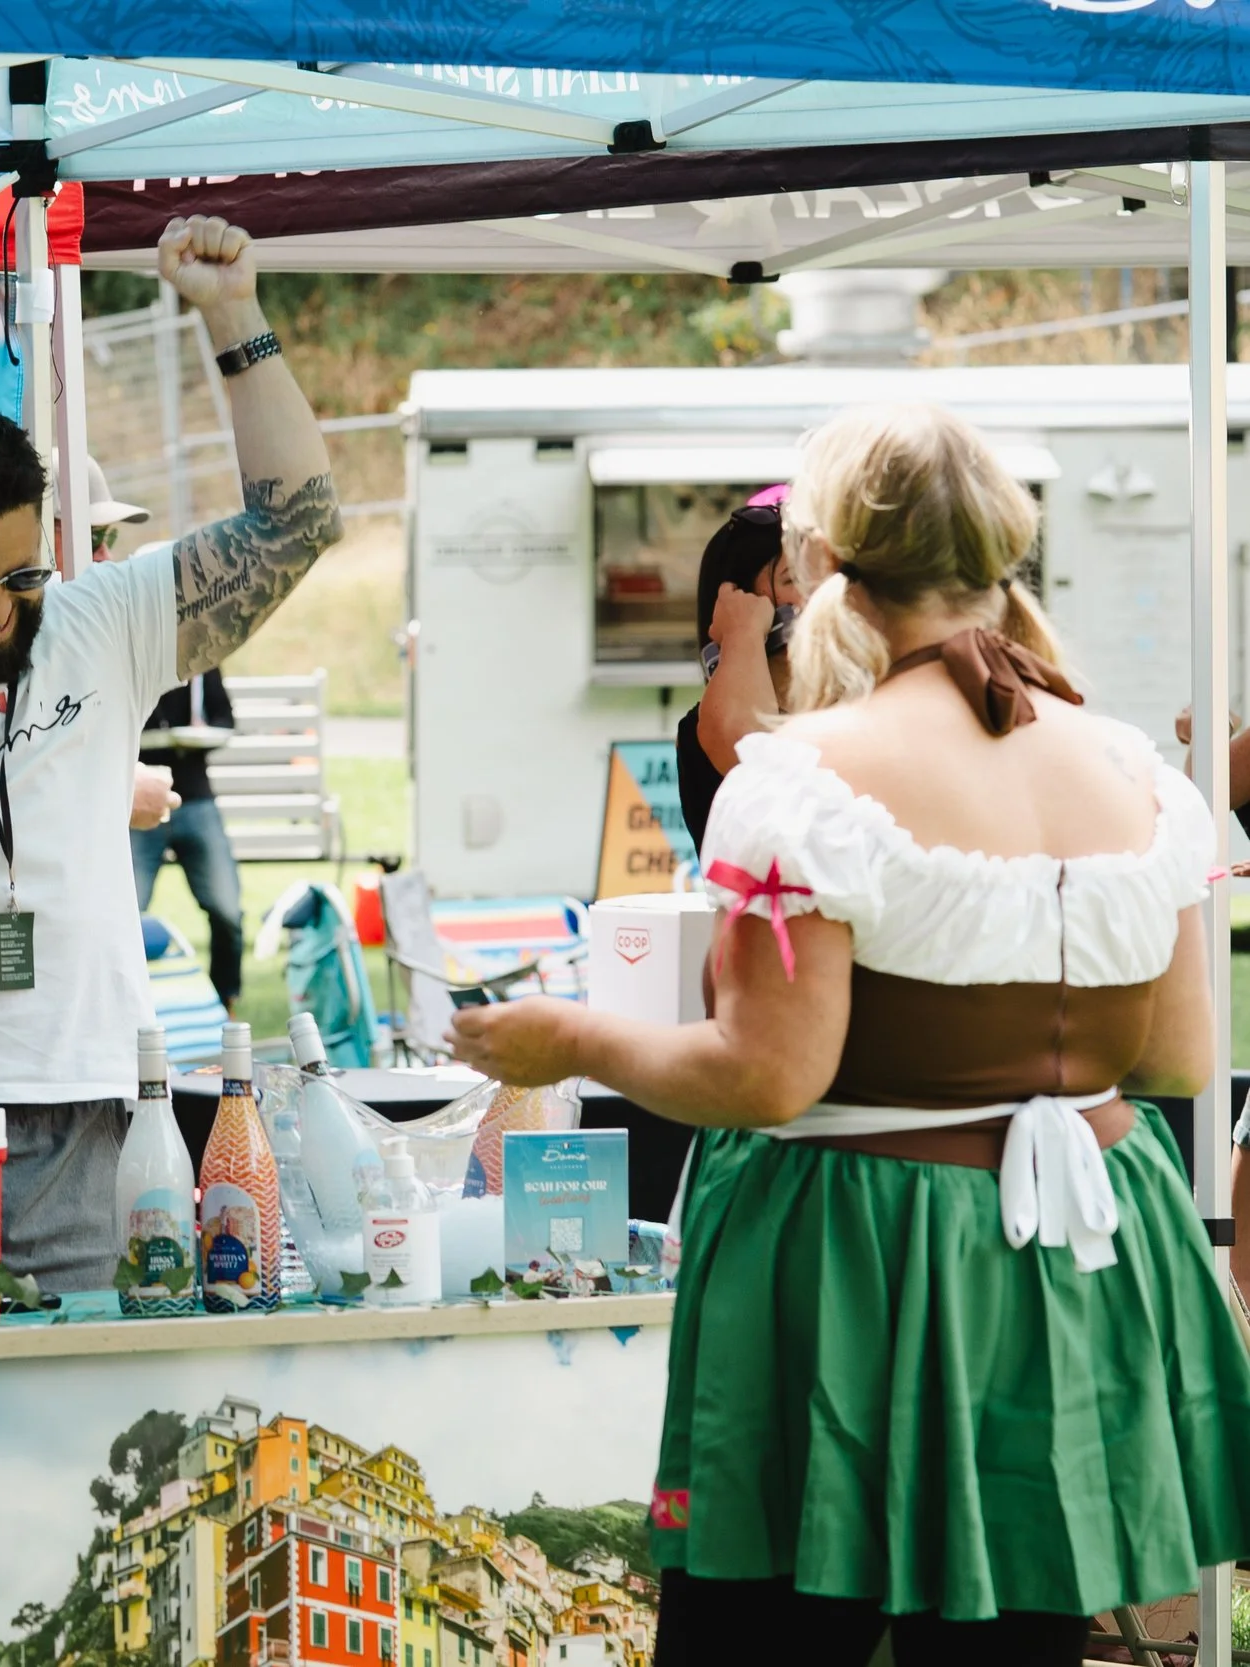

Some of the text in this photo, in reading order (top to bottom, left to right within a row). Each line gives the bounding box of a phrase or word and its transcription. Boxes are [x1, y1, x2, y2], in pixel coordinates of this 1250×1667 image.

[640, 758, 677, 786] JA
[555, 1180, 580, 1192] FOR
[581, 1179, 608, 1192] OUR
